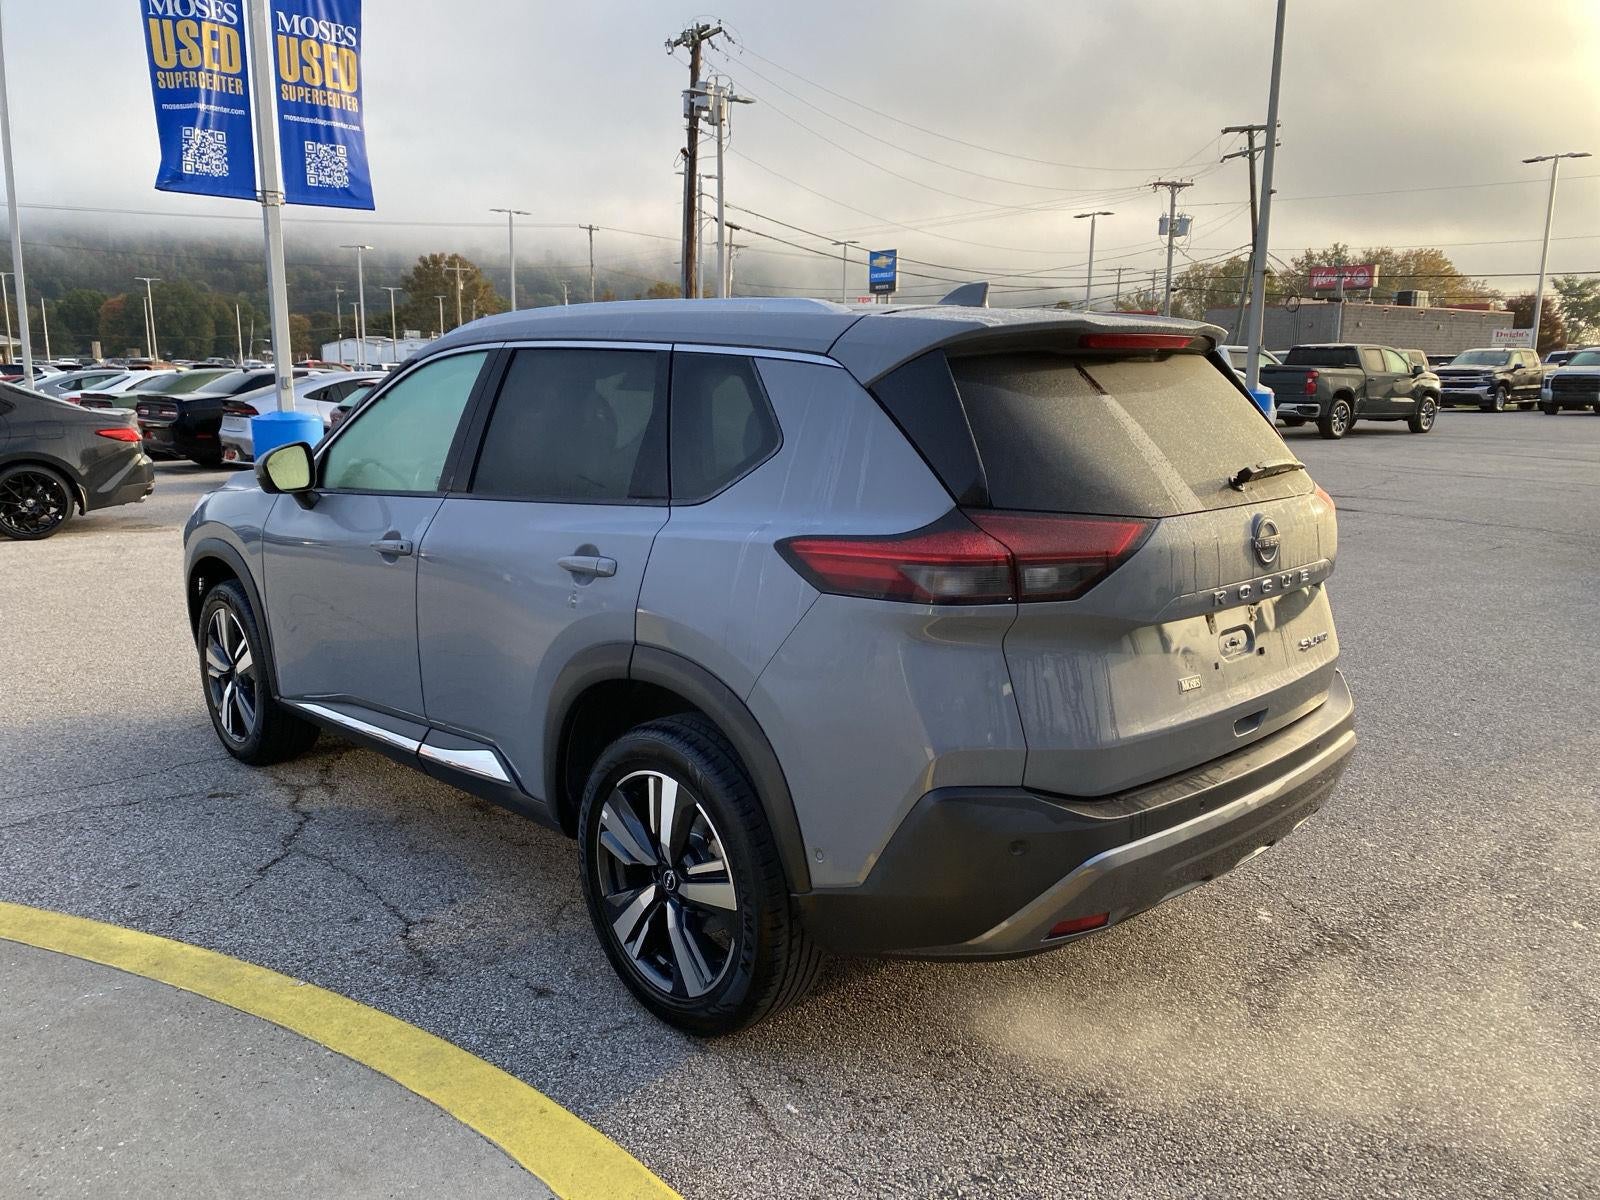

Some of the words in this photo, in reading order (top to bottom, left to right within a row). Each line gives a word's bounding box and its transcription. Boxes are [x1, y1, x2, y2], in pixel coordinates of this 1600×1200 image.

[148, 0, 238, 25] MOSES
[276, 11, 357, 47] MOSES
[148, 18, 242, 74] USED
[277, 35, 358, 93] USED
[157, 71, 243, 95] SUPERCENTER
[281, 84, 359, 113] SUPERCENTER
[162, 103, 245, 116] mosesusedsupercenter.com
[1214, 569, 1310, 605] ROGUE
